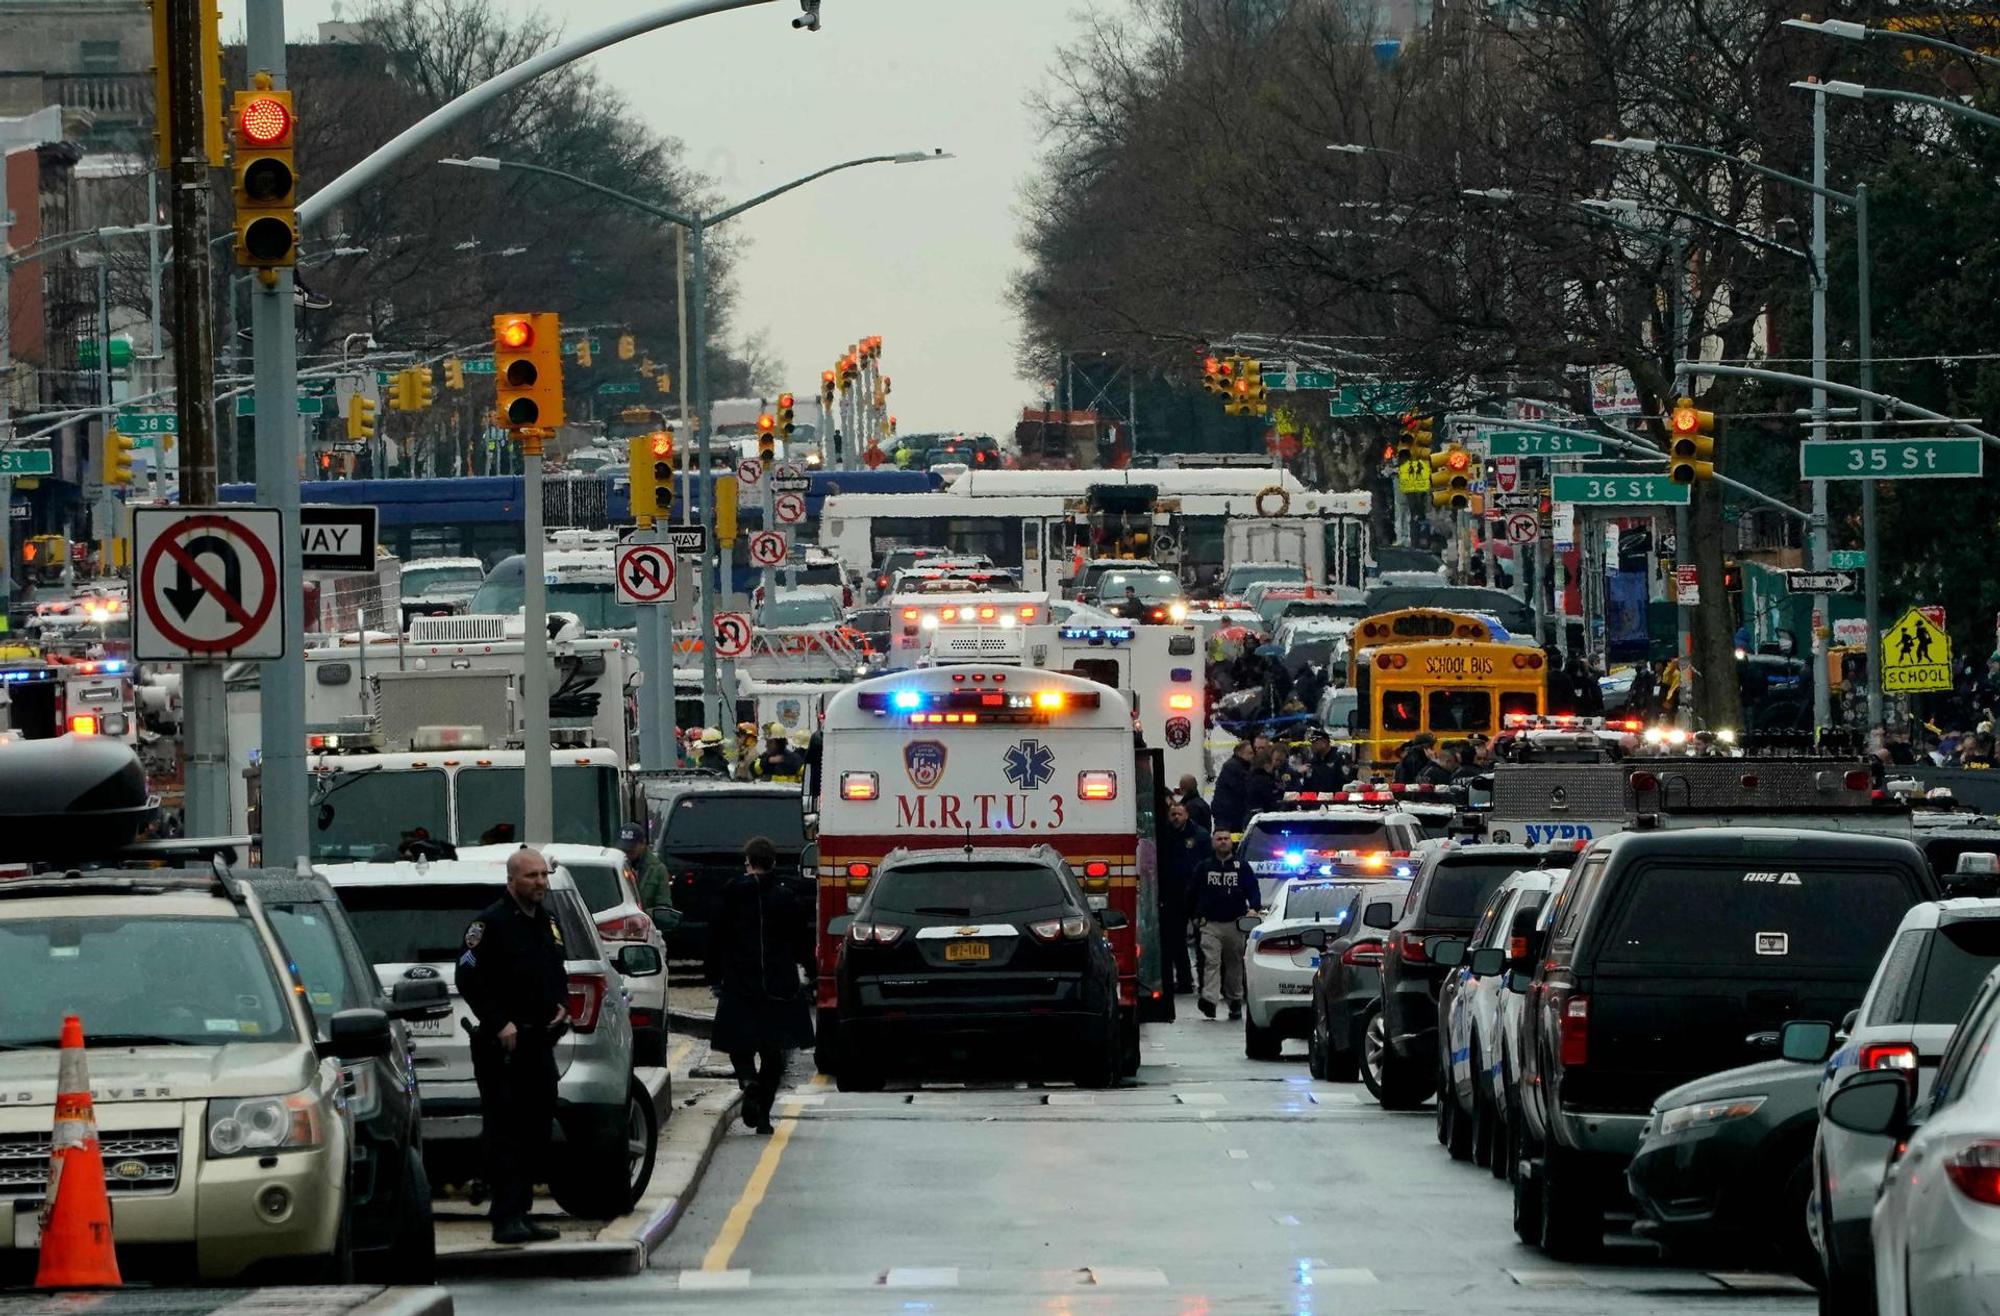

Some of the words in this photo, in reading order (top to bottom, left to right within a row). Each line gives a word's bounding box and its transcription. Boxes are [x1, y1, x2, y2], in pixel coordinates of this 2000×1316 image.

[1304, 375, 1318, 386] St
[139, 418, 158, 431] 38
[165, 418, 175, 430] S
[1518, 436, 1542, 452] 37
[1551, 436, 1573, 450] St
[1, 455, 22, 469] St
[1848, 448, 1887, 470] 35
[1902, 446, 1936, 469] St
[1587, 481, 1617, 498] 36
[1628, 481, 1655, 498] St
[672, 534, 697, 546] WAY
[1837, 553, 1853, 567] 36
[1796, 576, 1816, 588] ONE
[1825, 575, 1845, 587] WAY
[1066, 630, 1098, 638] IT'S
[1106, 630, 1129, 638] THE
[1426, 656, 1467, 675] SCHOOL
[1471, 656, 1493, 674] BUS
[1889, 669, 1945, 684] SCHOOL
[895, 794, 1037, 829] M.R.T.U.
[1047, 794, 1064, 829] 3
[1525, 824, 1593, 845] NYPD
[1207, 871, 1238, 887] POLICE
[411, 967, 432, 978] Ford
